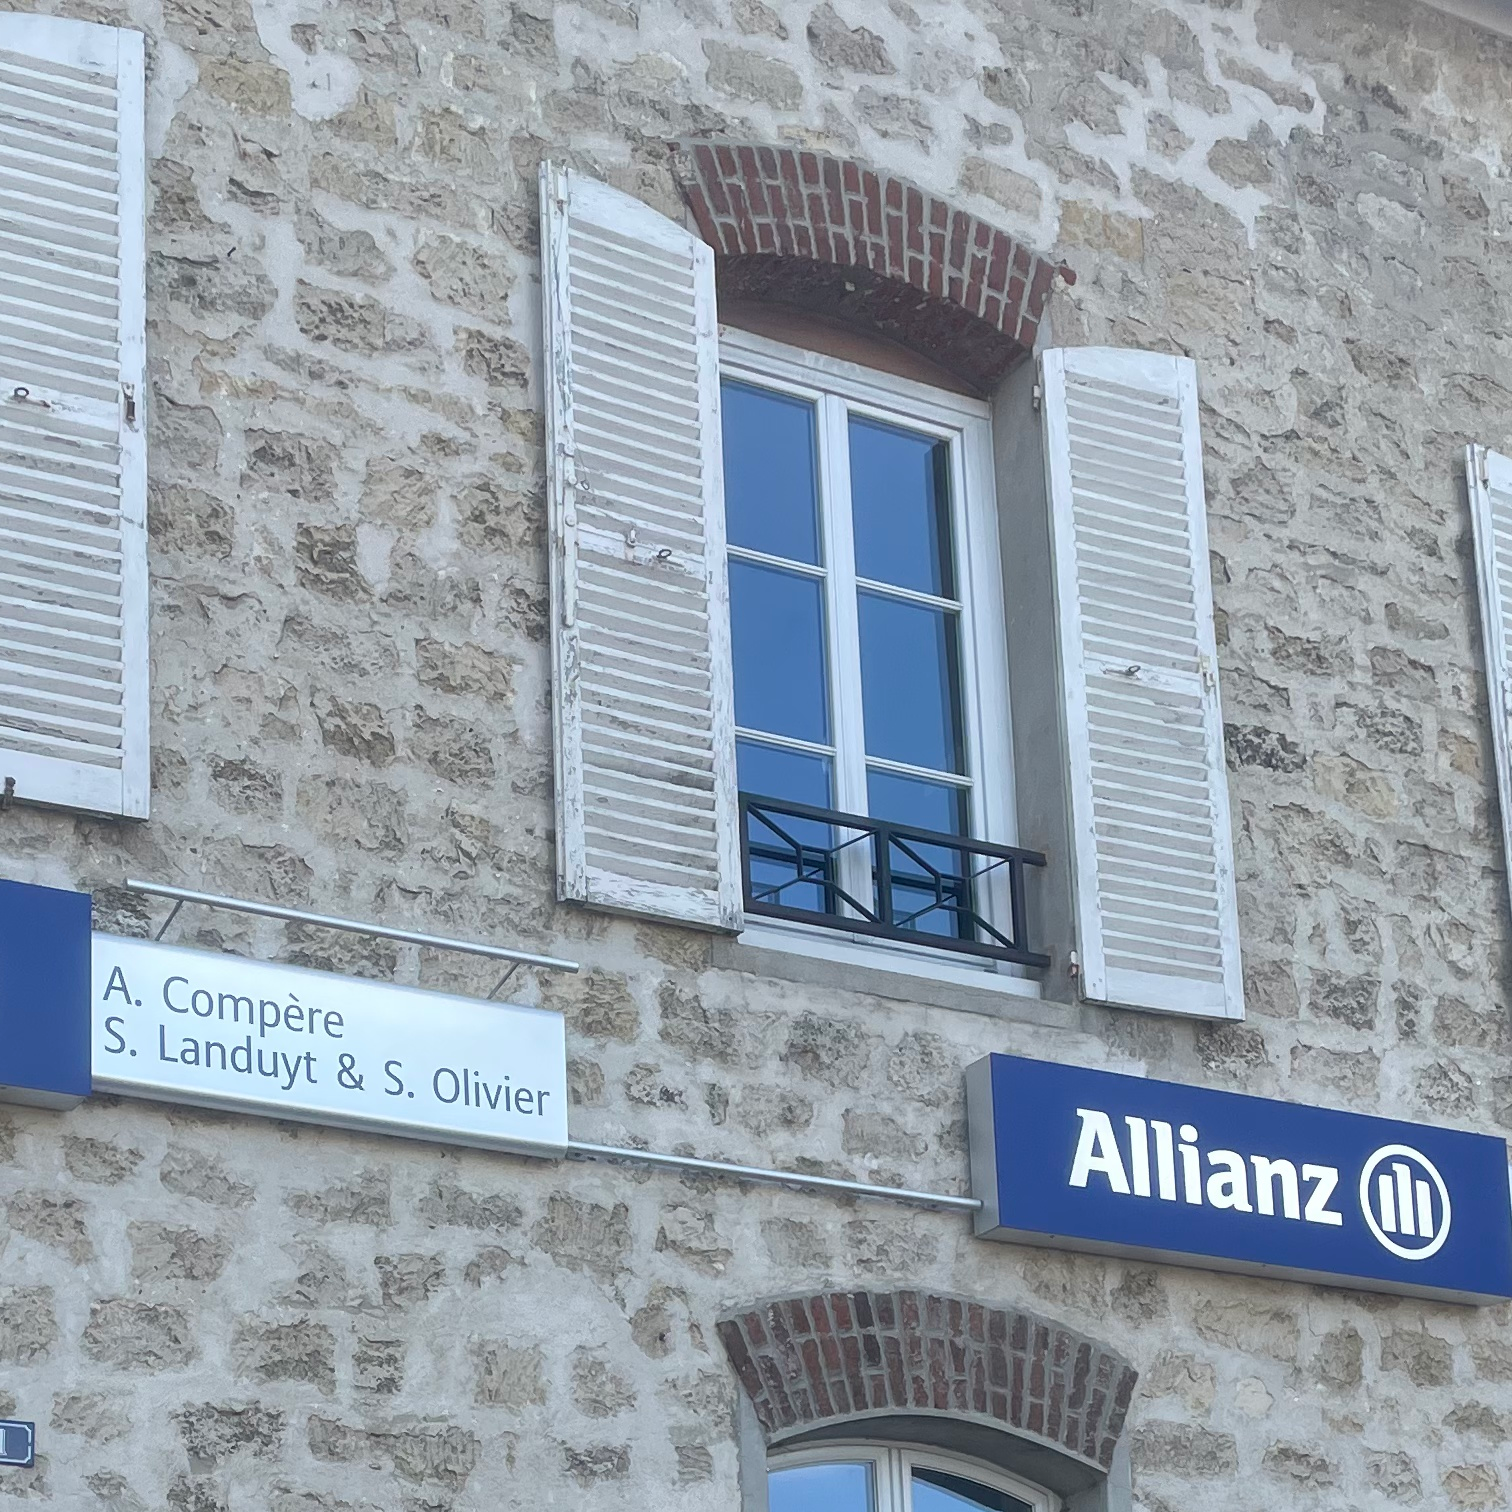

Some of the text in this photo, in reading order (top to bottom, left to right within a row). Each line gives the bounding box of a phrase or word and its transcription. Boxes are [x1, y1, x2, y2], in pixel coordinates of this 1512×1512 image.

[102, 965, 345, 1039] A. Compère
[103, 1016, 551, 1117] S. Landuyt & S. Olivier
[1068, 1107, 1343, 1227] Allianz
